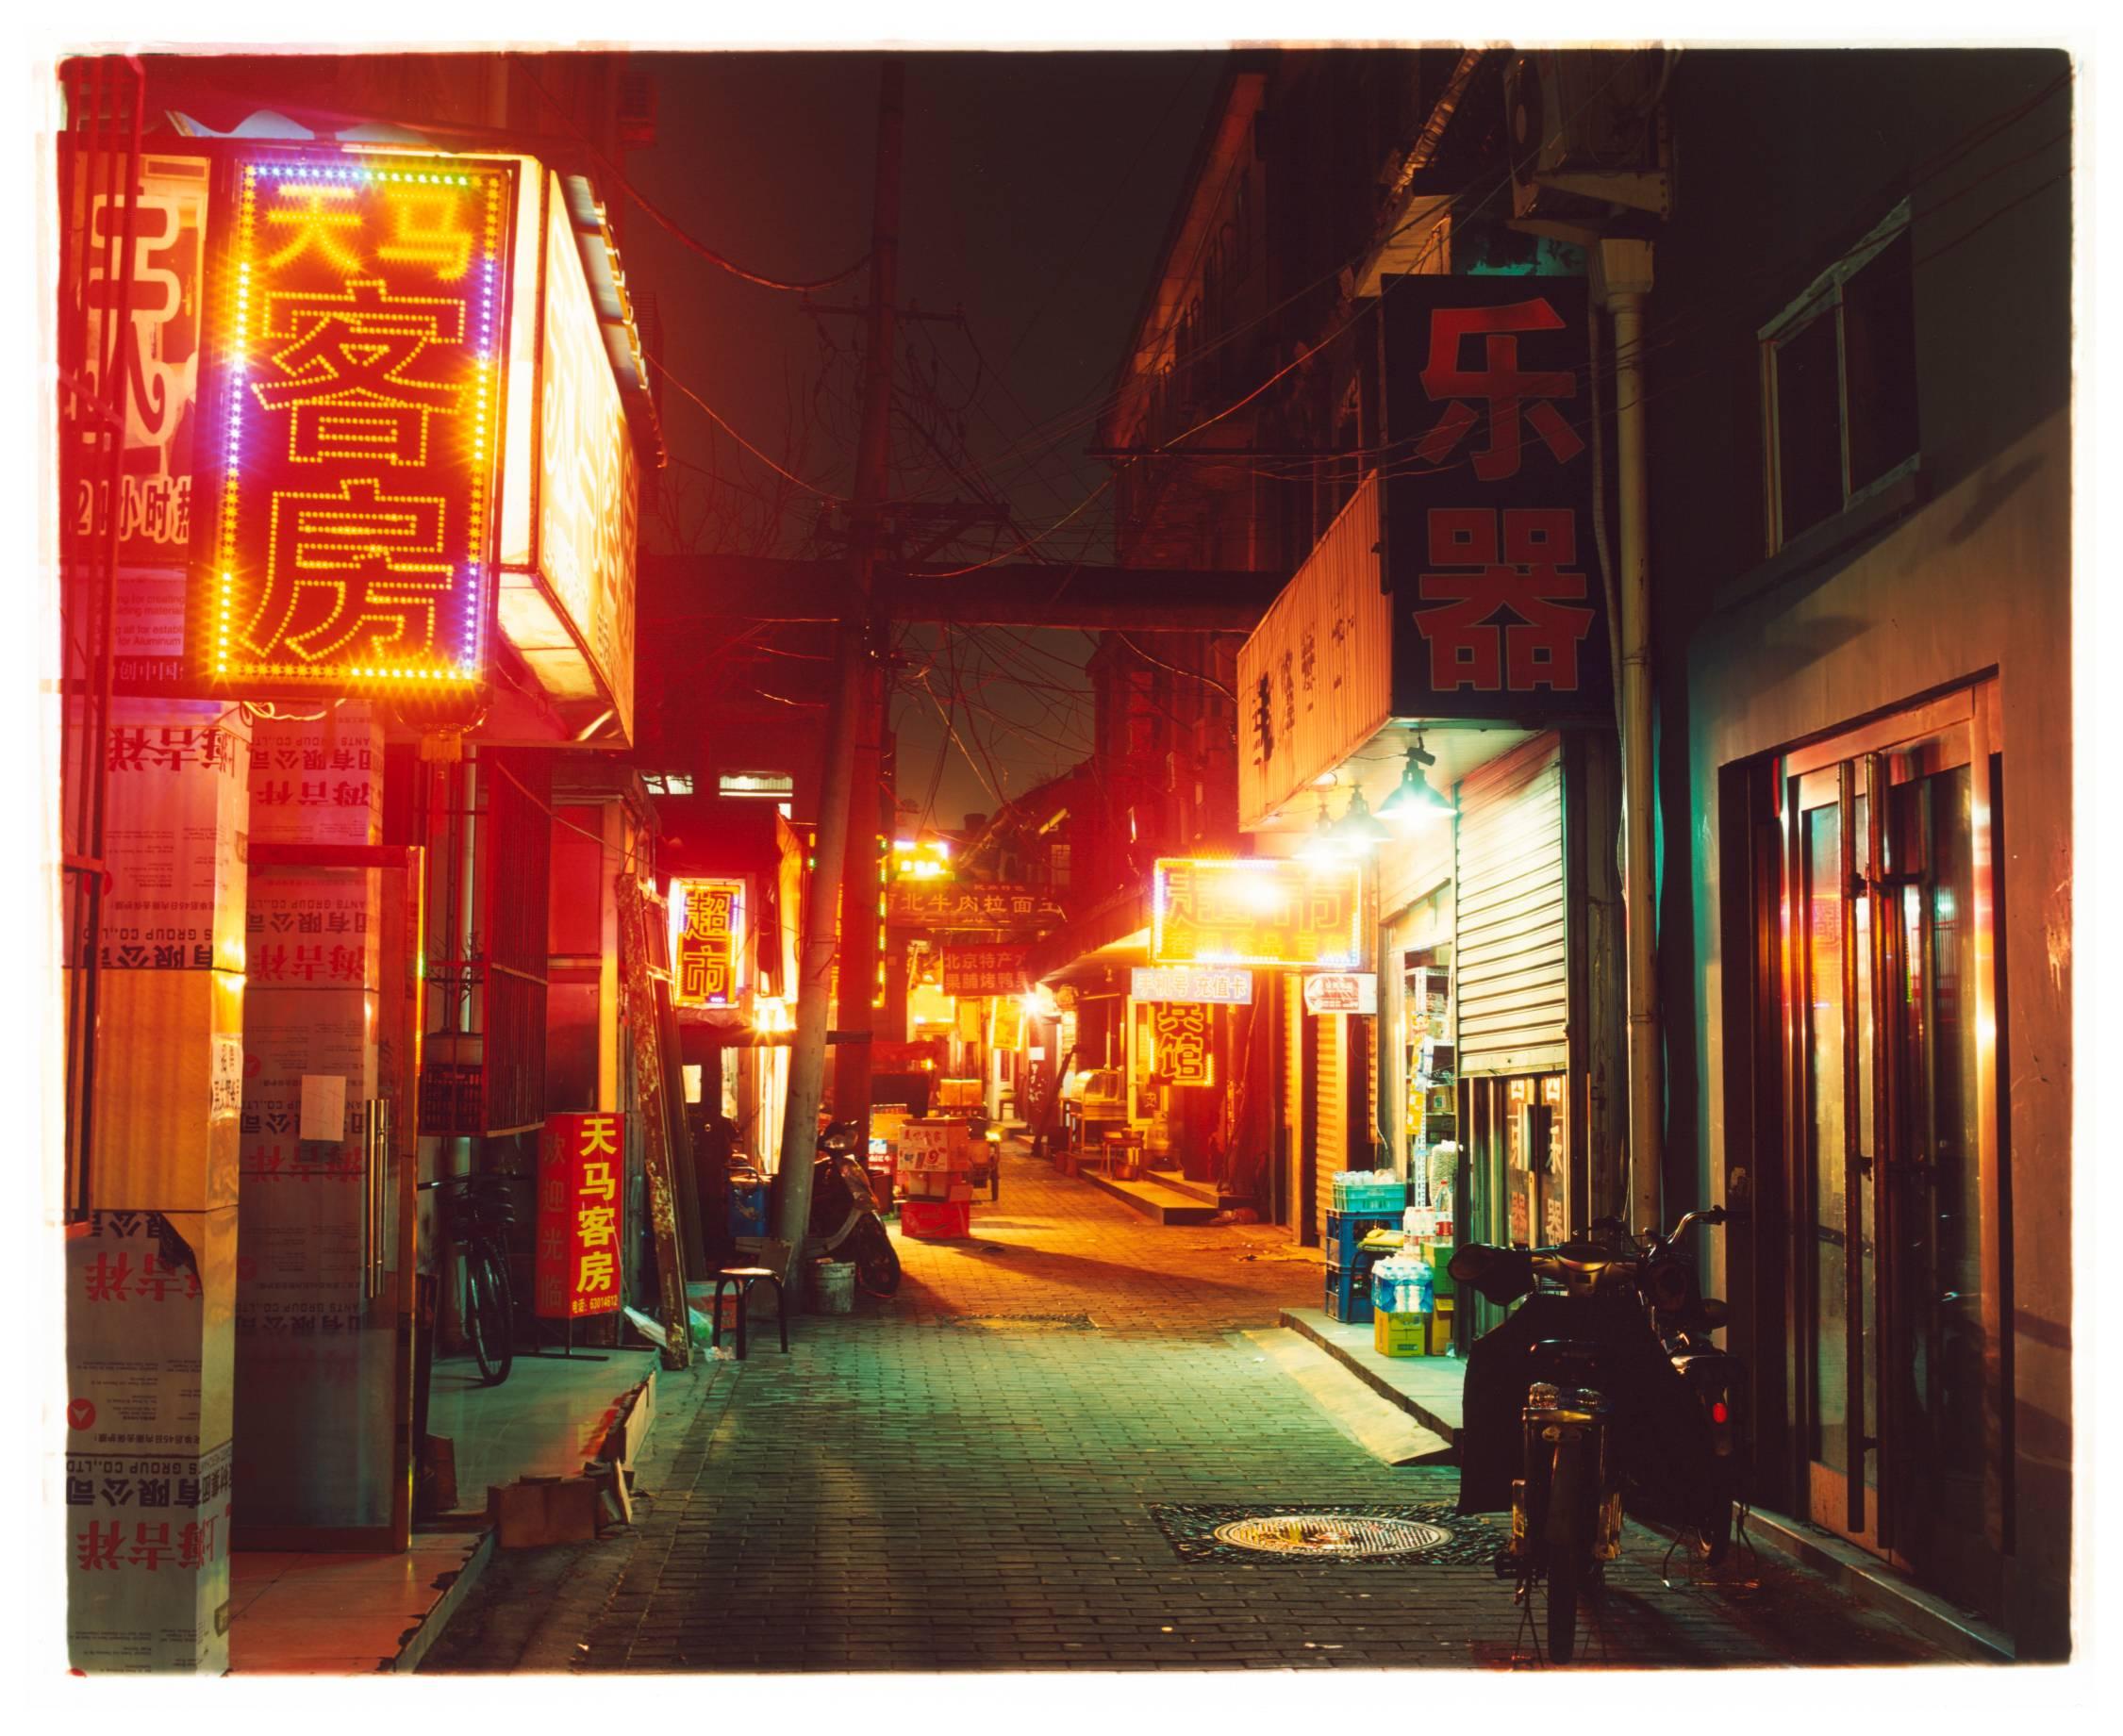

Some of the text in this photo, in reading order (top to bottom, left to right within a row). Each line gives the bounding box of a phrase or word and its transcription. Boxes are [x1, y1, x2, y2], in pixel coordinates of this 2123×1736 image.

[265, 184, 473, 281] 天马
[239, 279, 472, 661] 客房
[1413, 297, 1596, 691] 乐器
[144, 928, 197, 941] GROUP
[684, 888, 732, 997] 超市
[1136, 972, 1249, 1000] 手机号 充值卡
[540, 1132, 567, 1313] 欢迎光临
[575, 1118, 618, 1293] 天马客房
[129, 1462, 182, 1475] GROUP
